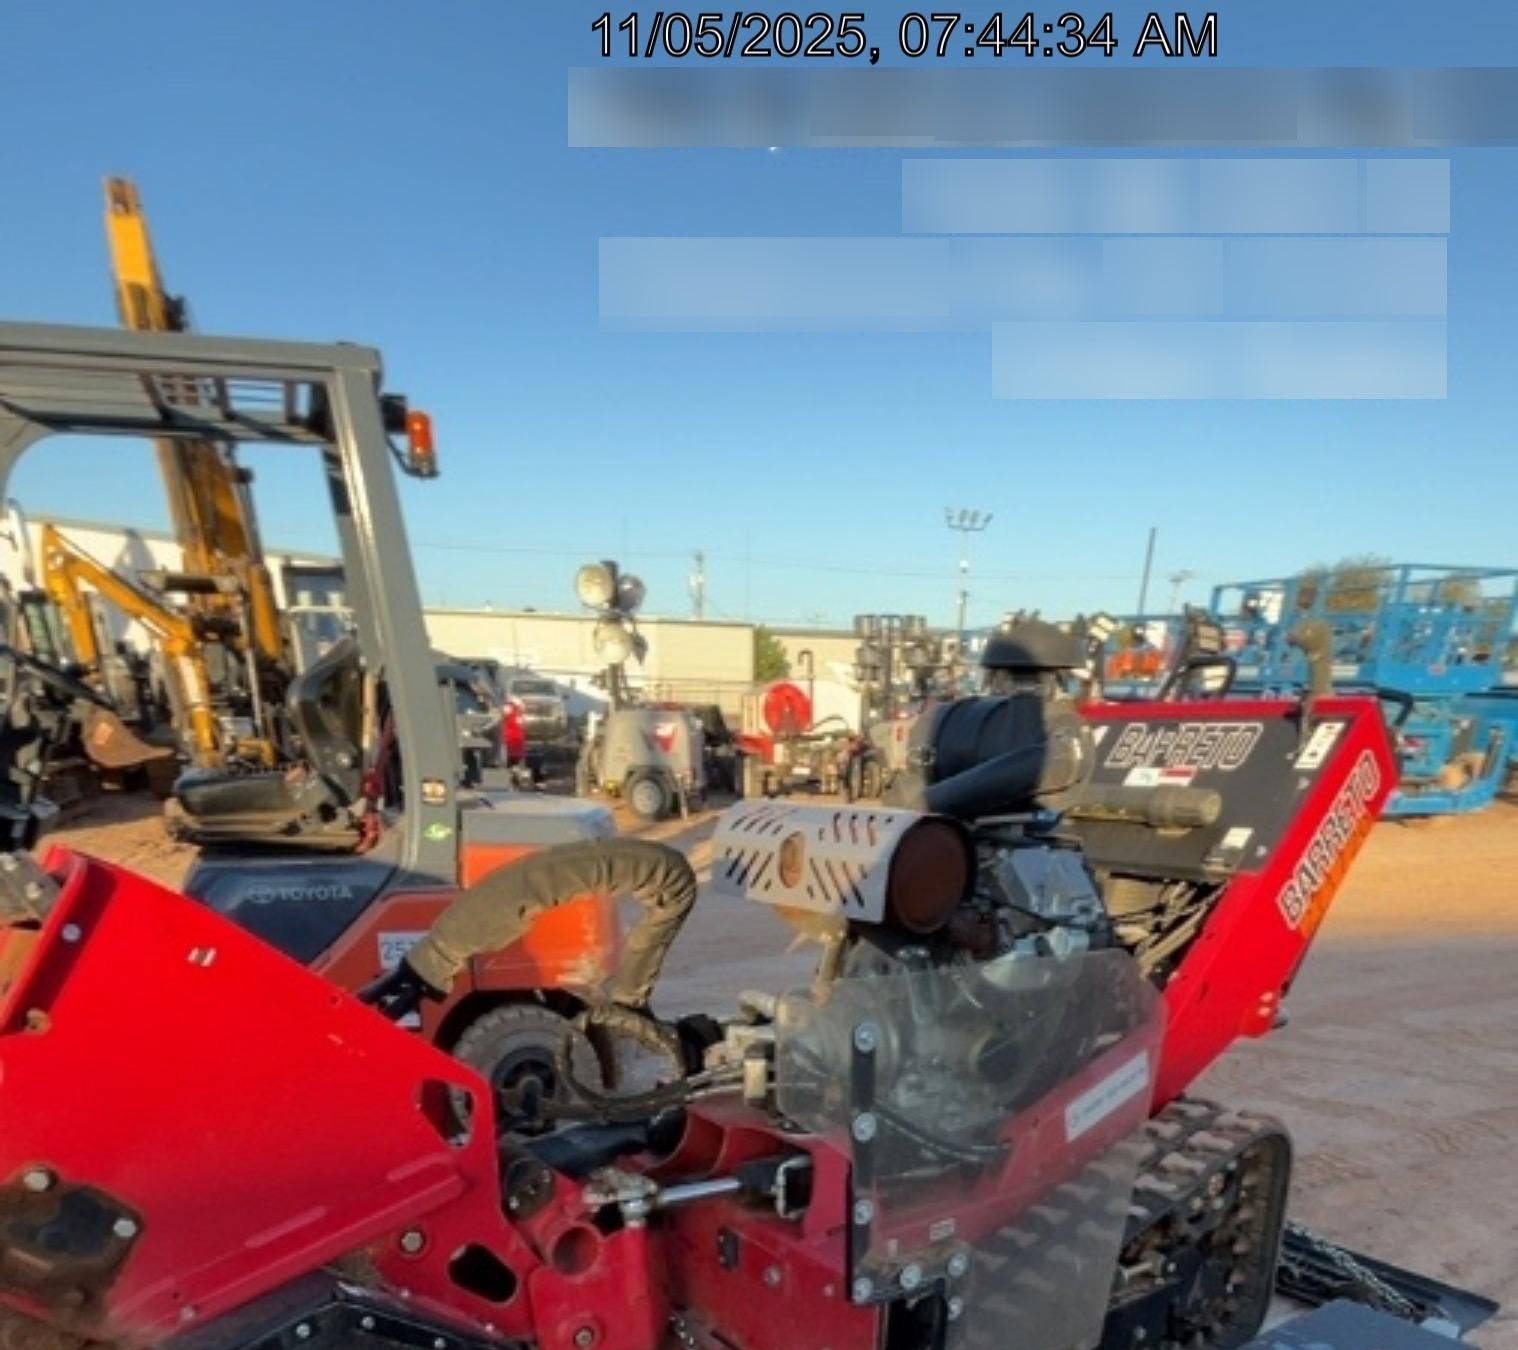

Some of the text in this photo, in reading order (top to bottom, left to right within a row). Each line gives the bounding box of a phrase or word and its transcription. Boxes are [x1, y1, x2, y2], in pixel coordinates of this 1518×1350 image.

[1104, 722, 1264, 770] BARRETO
[1277, 750, 1382, 929] BARRETO
[278, 885, 353, 901] TOYOTA
